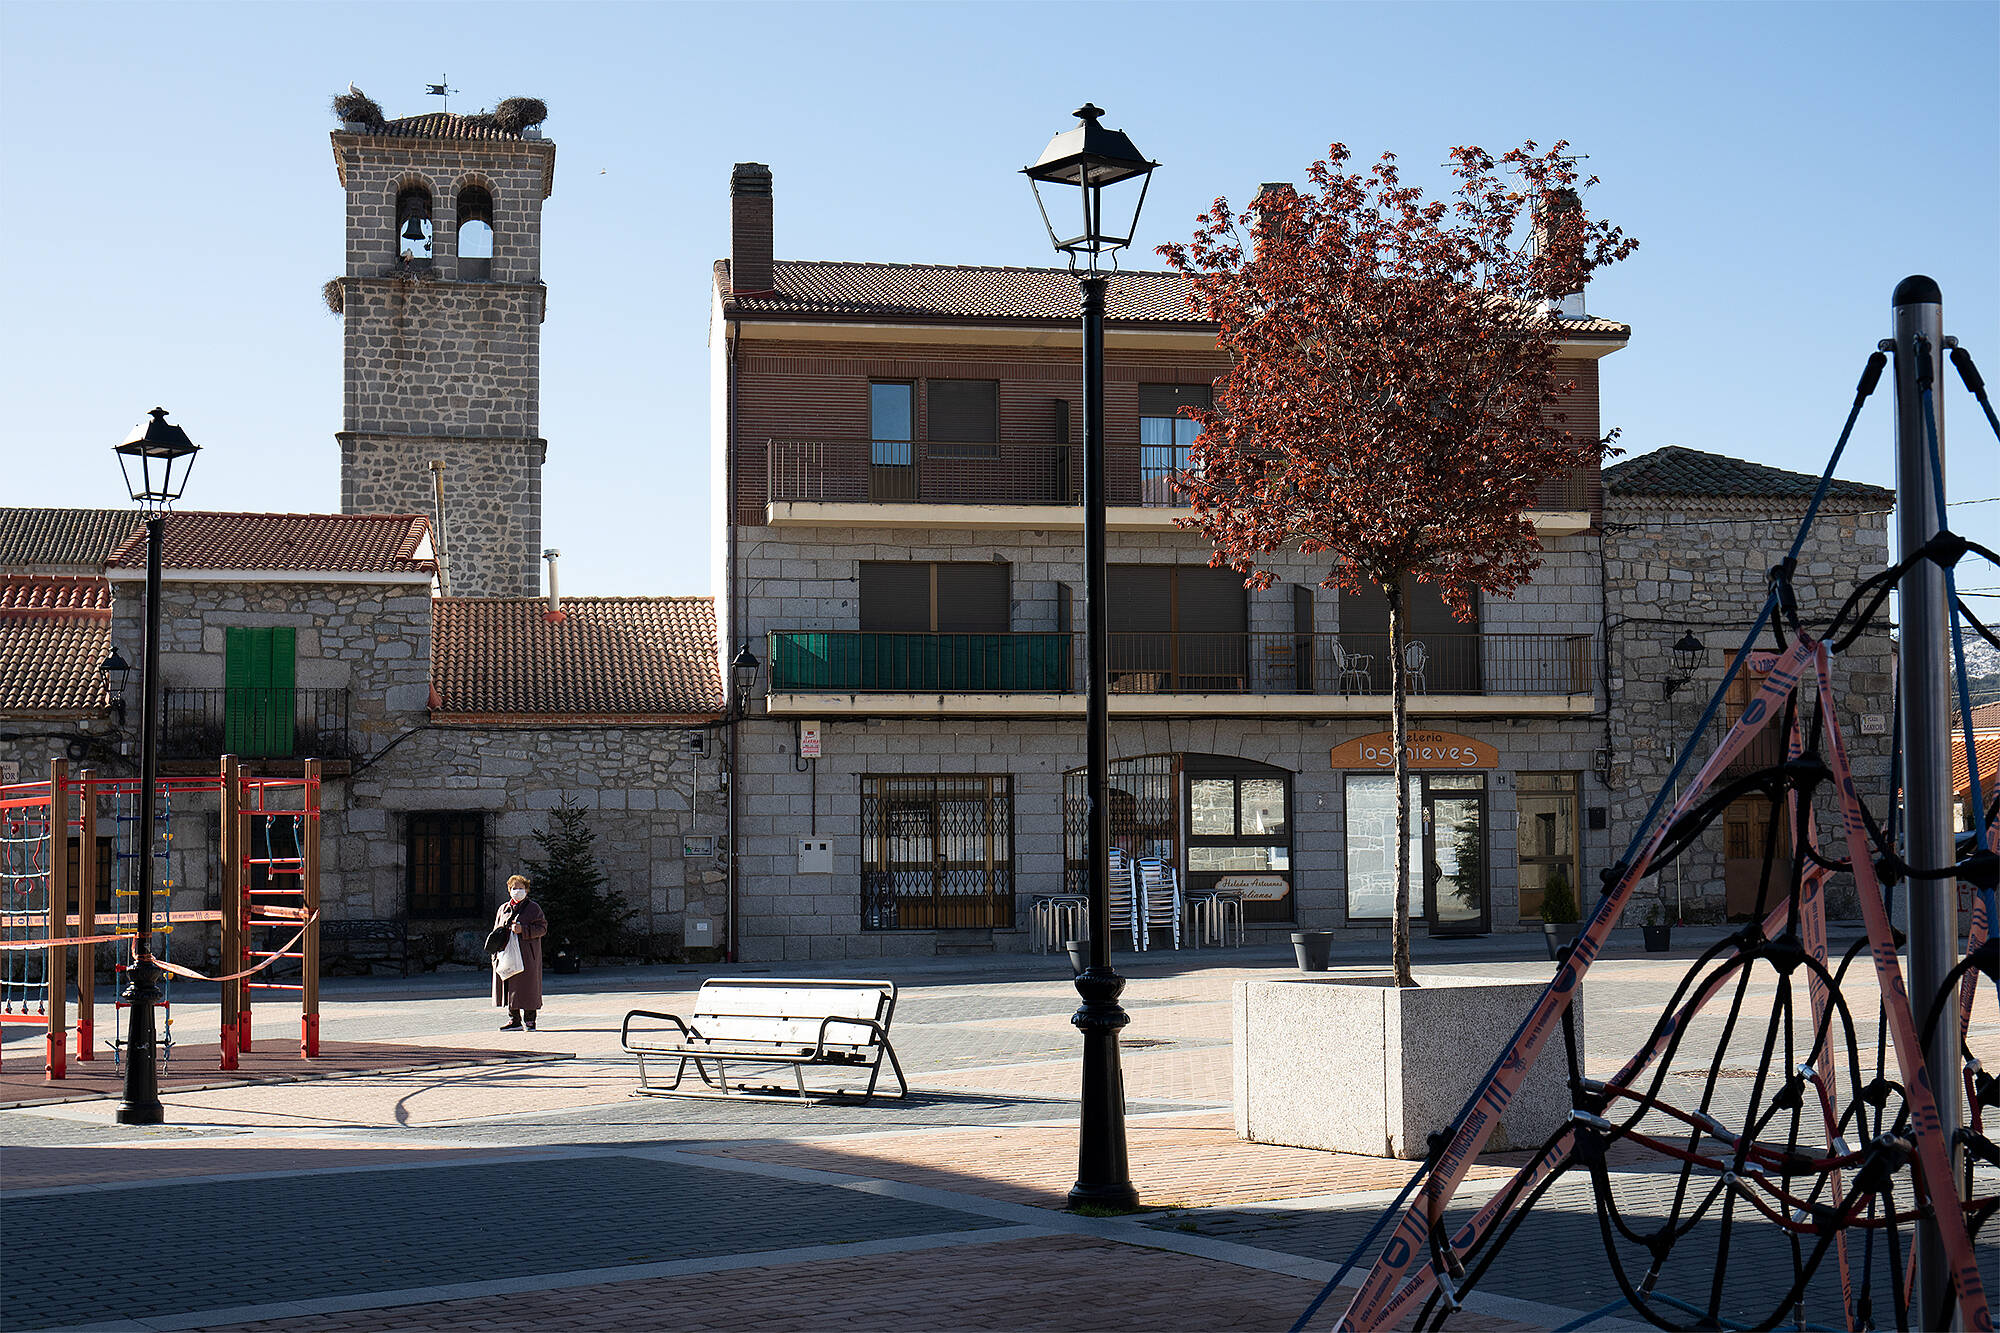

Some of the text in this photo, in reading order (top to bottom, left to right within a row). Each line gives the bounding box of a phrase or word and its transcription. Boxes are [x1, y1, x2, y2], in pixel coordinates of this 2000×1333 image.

[1387, 733, 1442, 742] ceteria
[1223, 878, 1282, 888] Helados Artesanos
[1523, 1033, 1538, 1050] PASO
[1359, 1307, 1373, 1323] PASO
